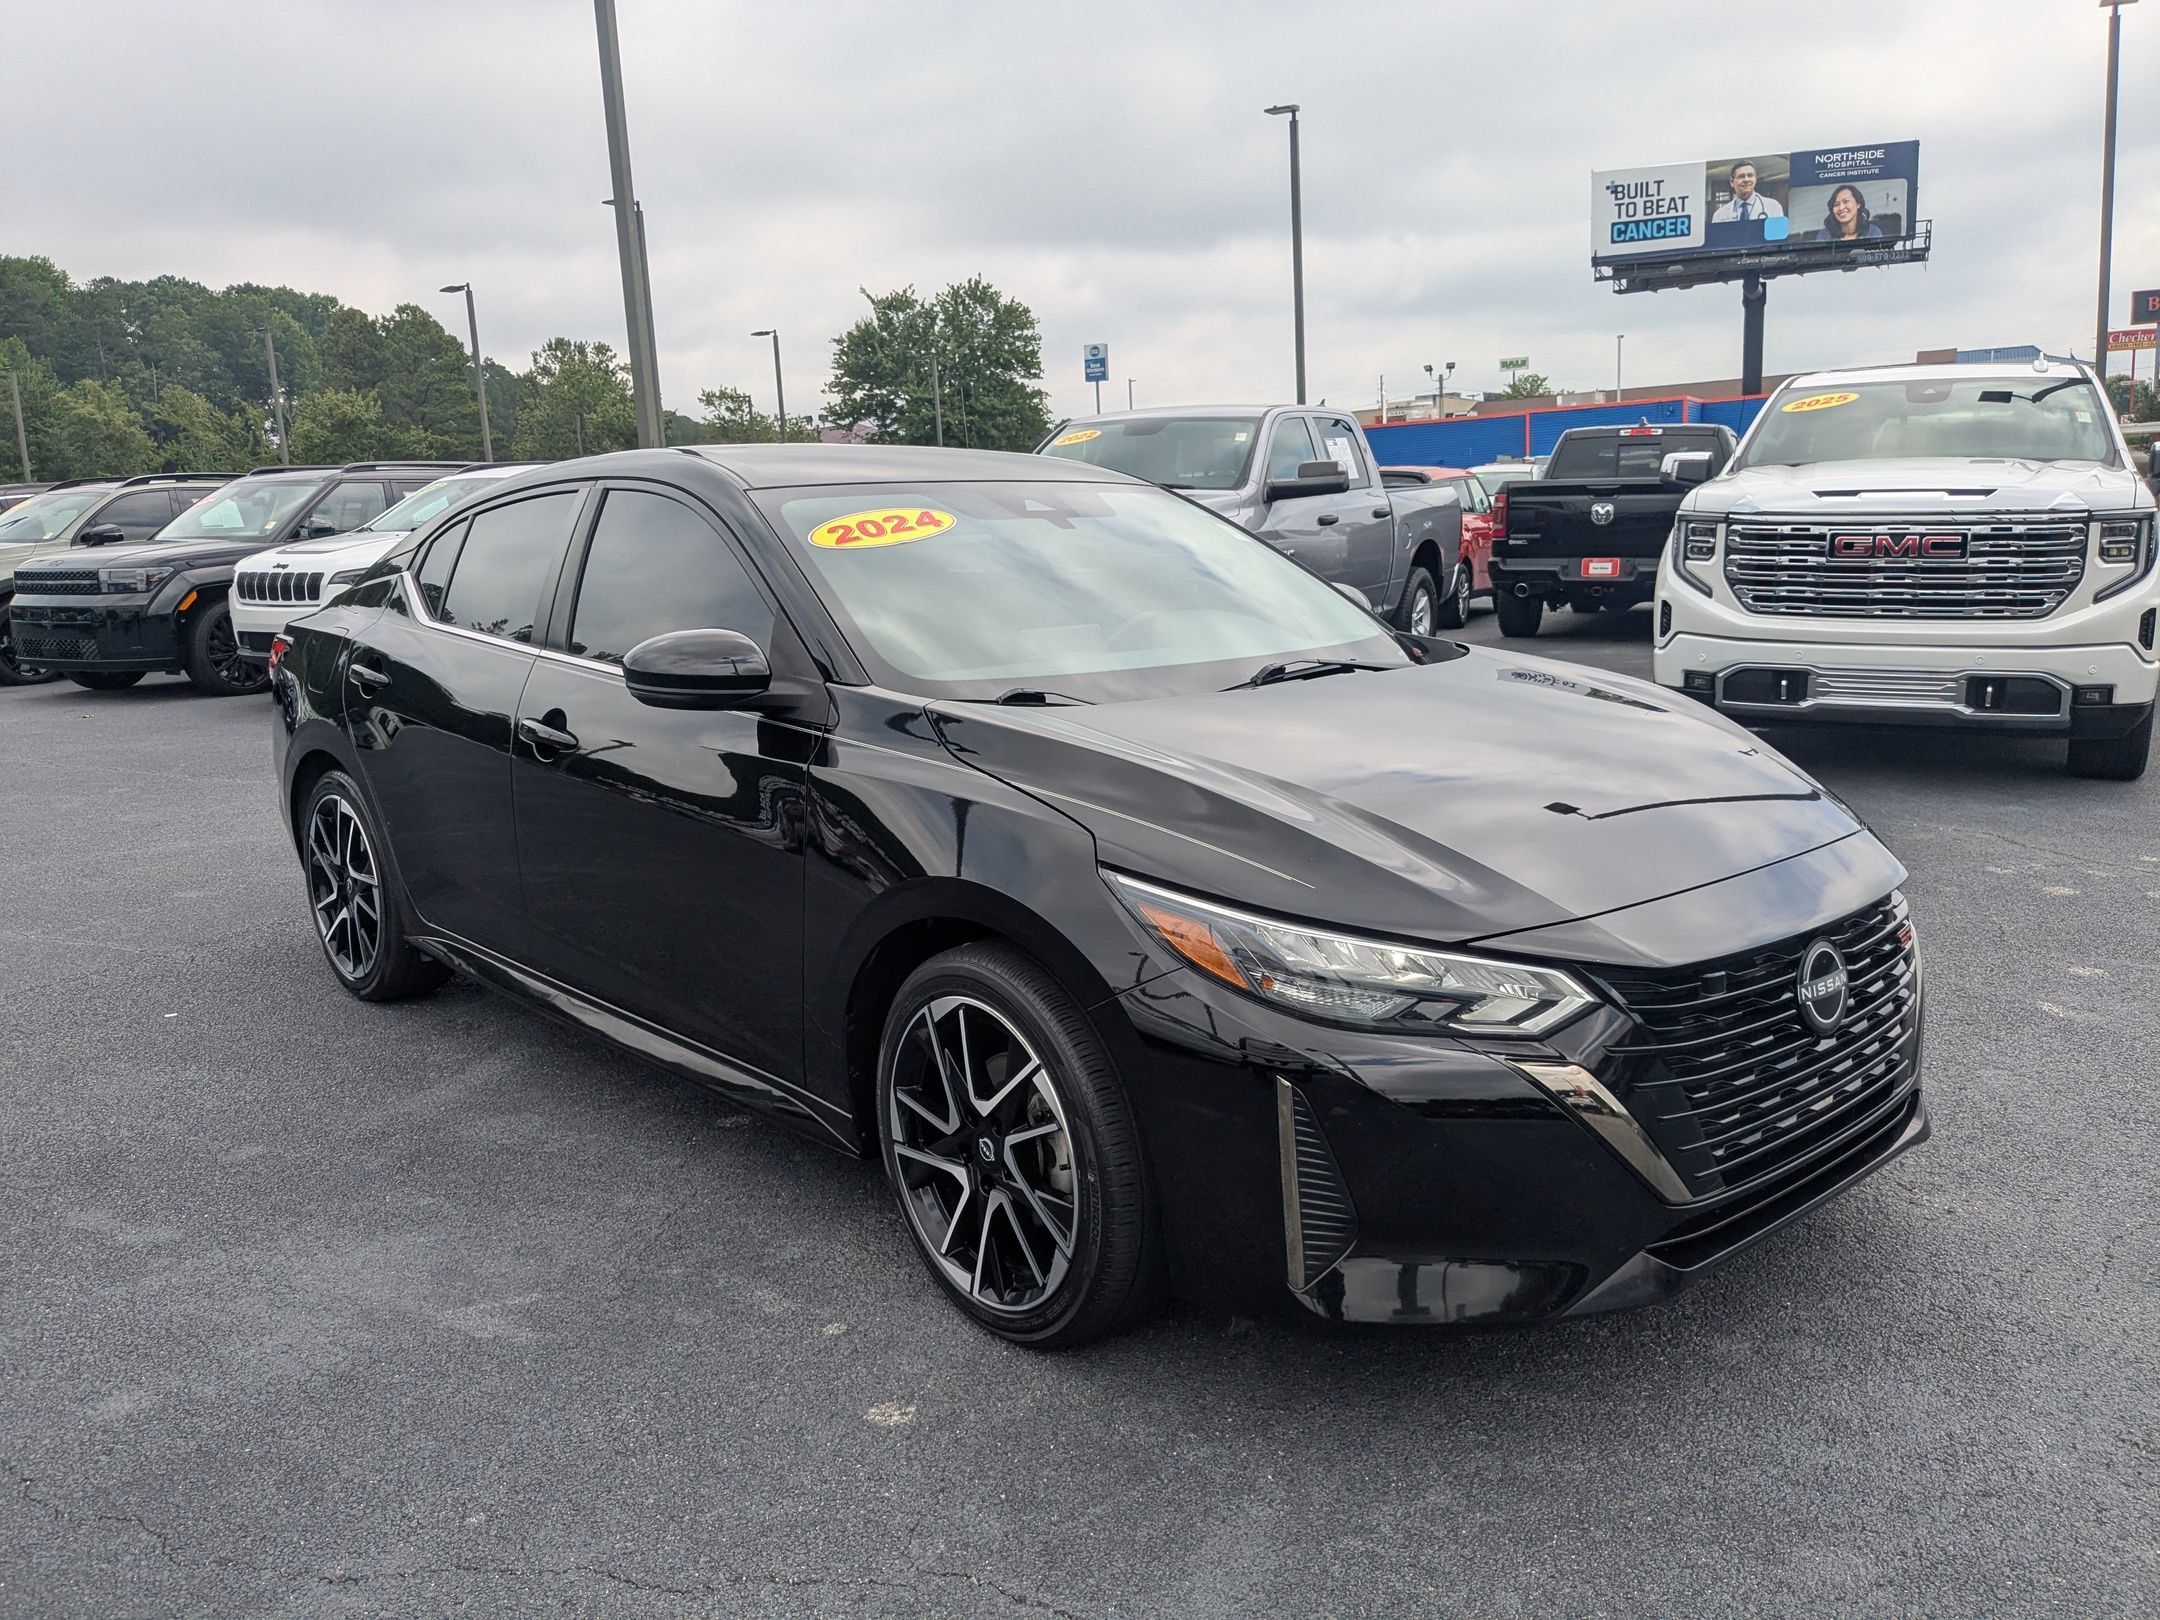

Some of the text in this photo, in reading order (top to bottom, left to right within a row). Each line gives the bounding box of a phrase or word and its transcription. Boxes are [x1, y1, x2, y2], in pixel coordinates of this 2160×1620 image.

[1815, 149, 1885, 164] NORTHSIDE
[1827, 159, 1872, 169] HOSPITAL
[1846, 168, 1880, 176] INSTITUTE
[1614, 179, 1665, 201] BUILT
[1614, 195, 1689, 219] TO BEAT
[1613, 217, 1690, 241] CANCER
[1791, 394, 1850, 411] 2025
[827, 511, 944, 545] 2024
[1834, 535, 1962, 557] GMC
[1801, 971, 1847, 1000] NISSAN
